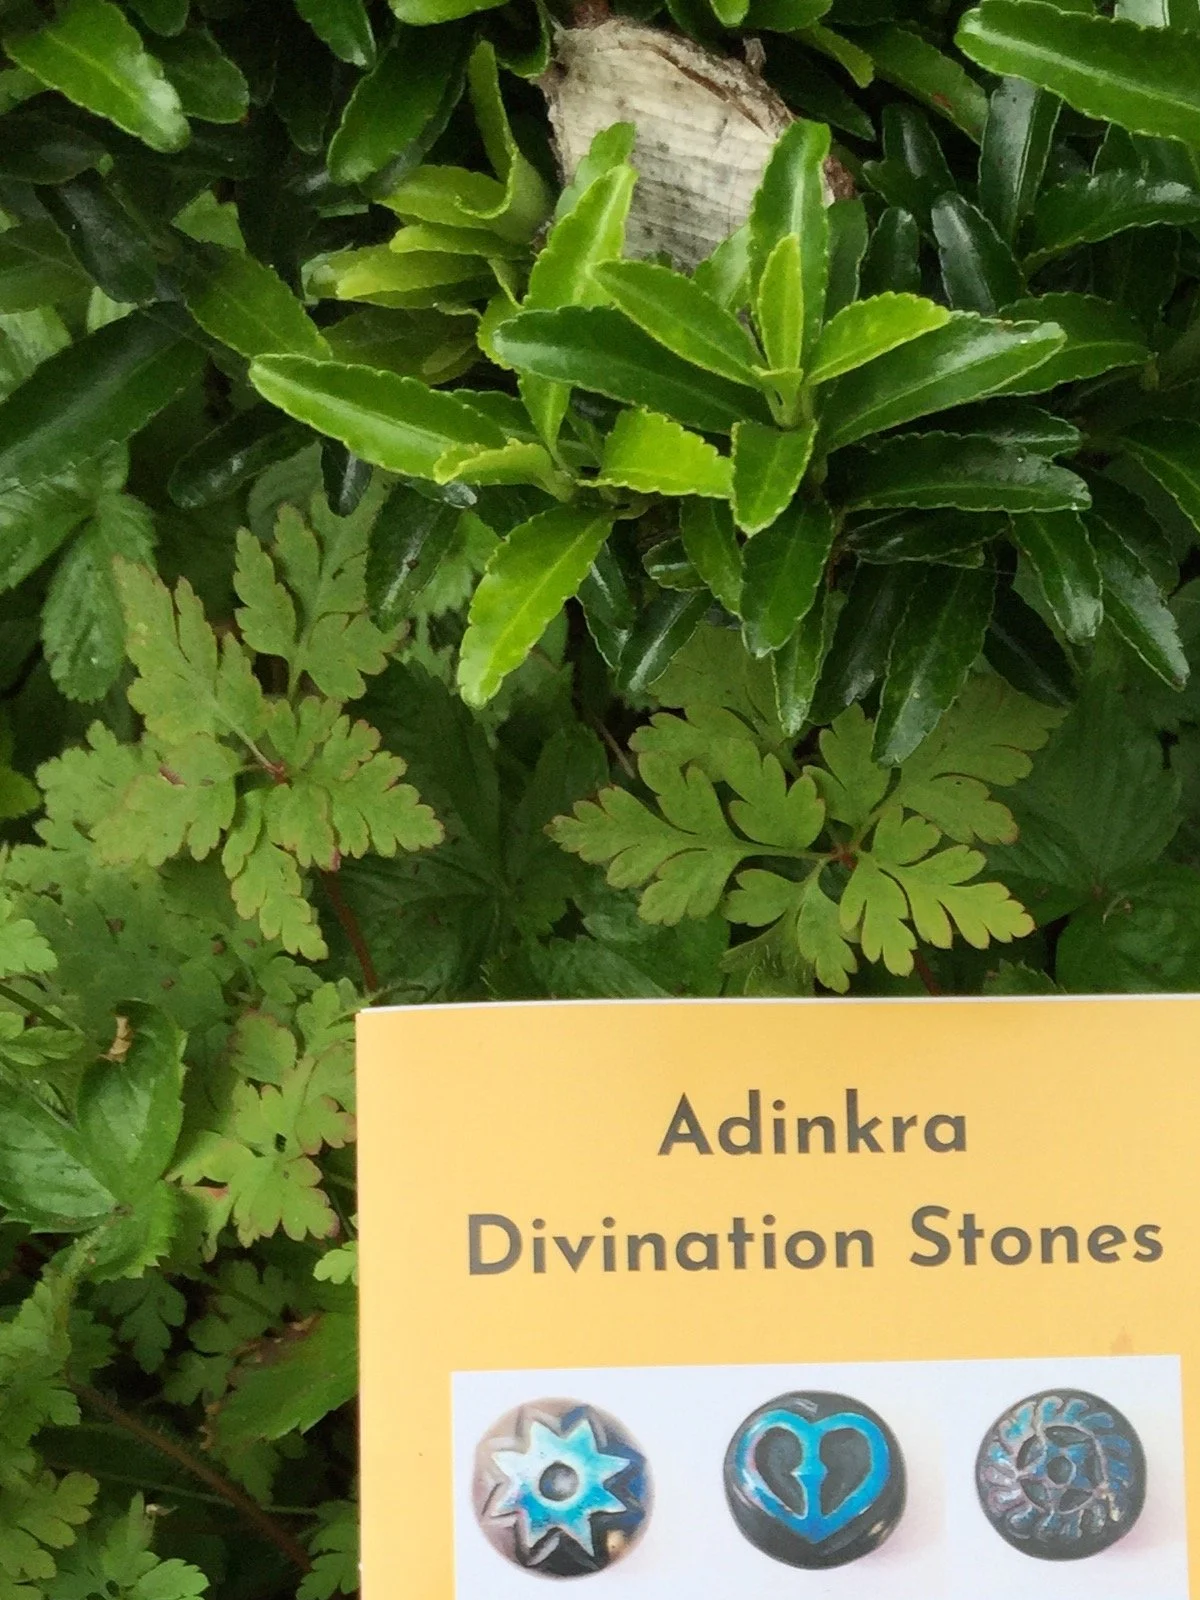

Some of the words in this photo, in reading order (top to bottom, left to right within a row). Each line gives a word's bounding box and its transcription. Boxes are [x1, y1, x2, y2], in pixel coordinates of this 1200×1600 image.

[657, 1088, 966, 1156] Adinkra
[468, 1213, 874, 1275] Divination
[909, 1205, 1163, 1267] Stones
